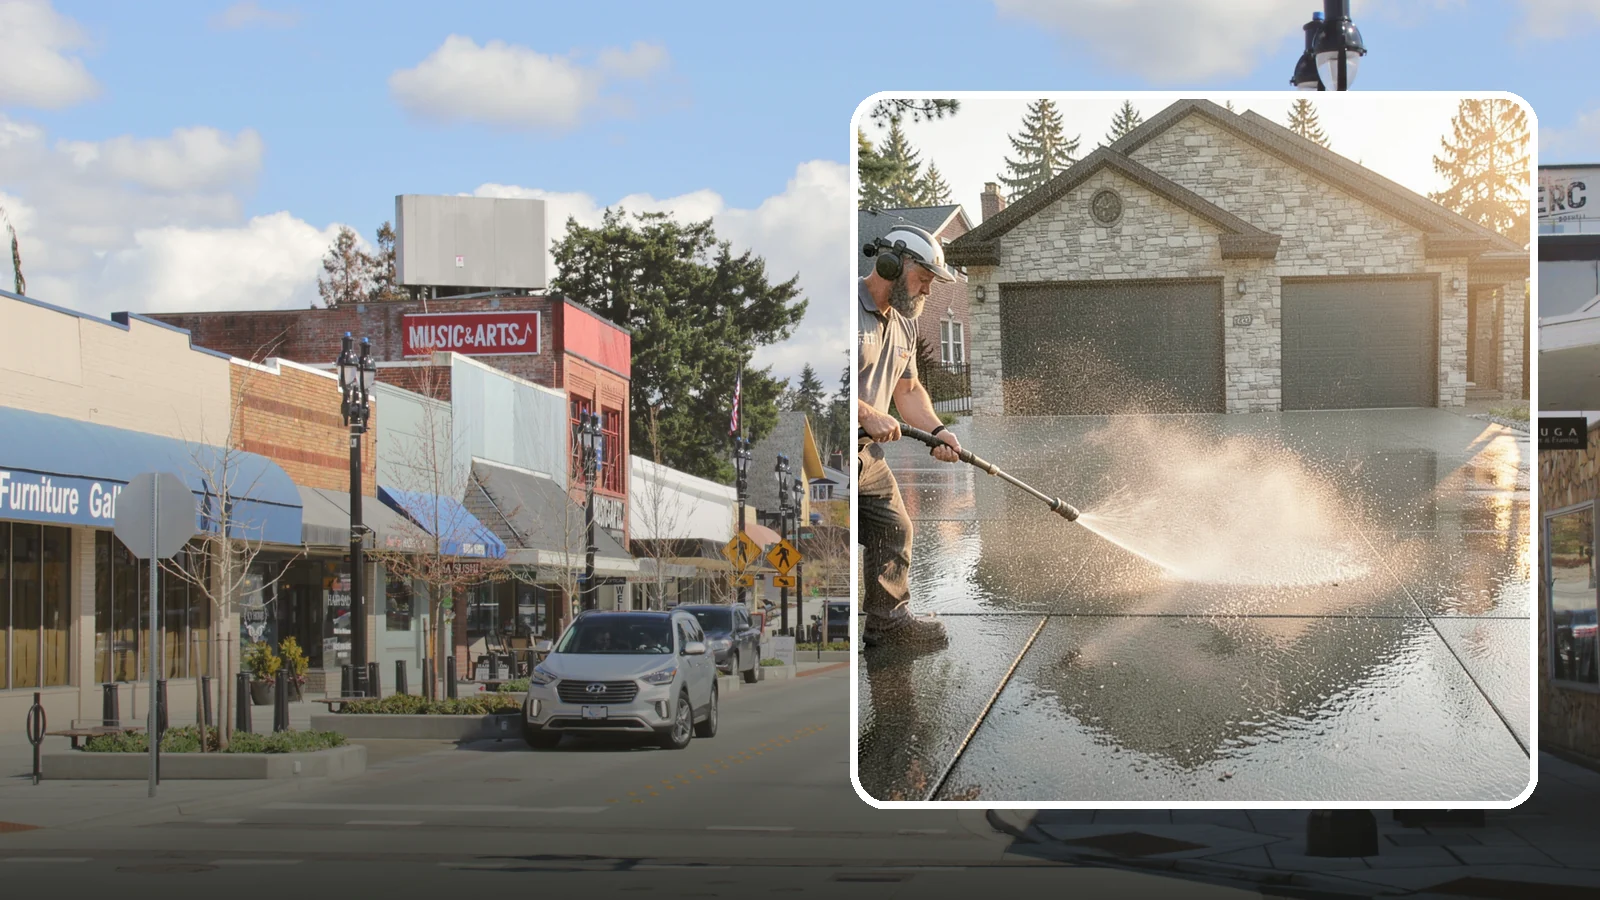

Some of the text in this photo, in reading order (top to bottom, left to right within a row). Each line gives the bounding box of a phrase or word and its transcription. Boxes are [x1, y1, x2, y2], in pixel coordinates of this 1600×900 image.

[408, 323, 519, 349] MUSIC&ARTS
[1540, 427, 1577, 437] UGA
[0, 471, 122, 519] Furniture Gal
[453, 563, 479, 574] SUSHI
